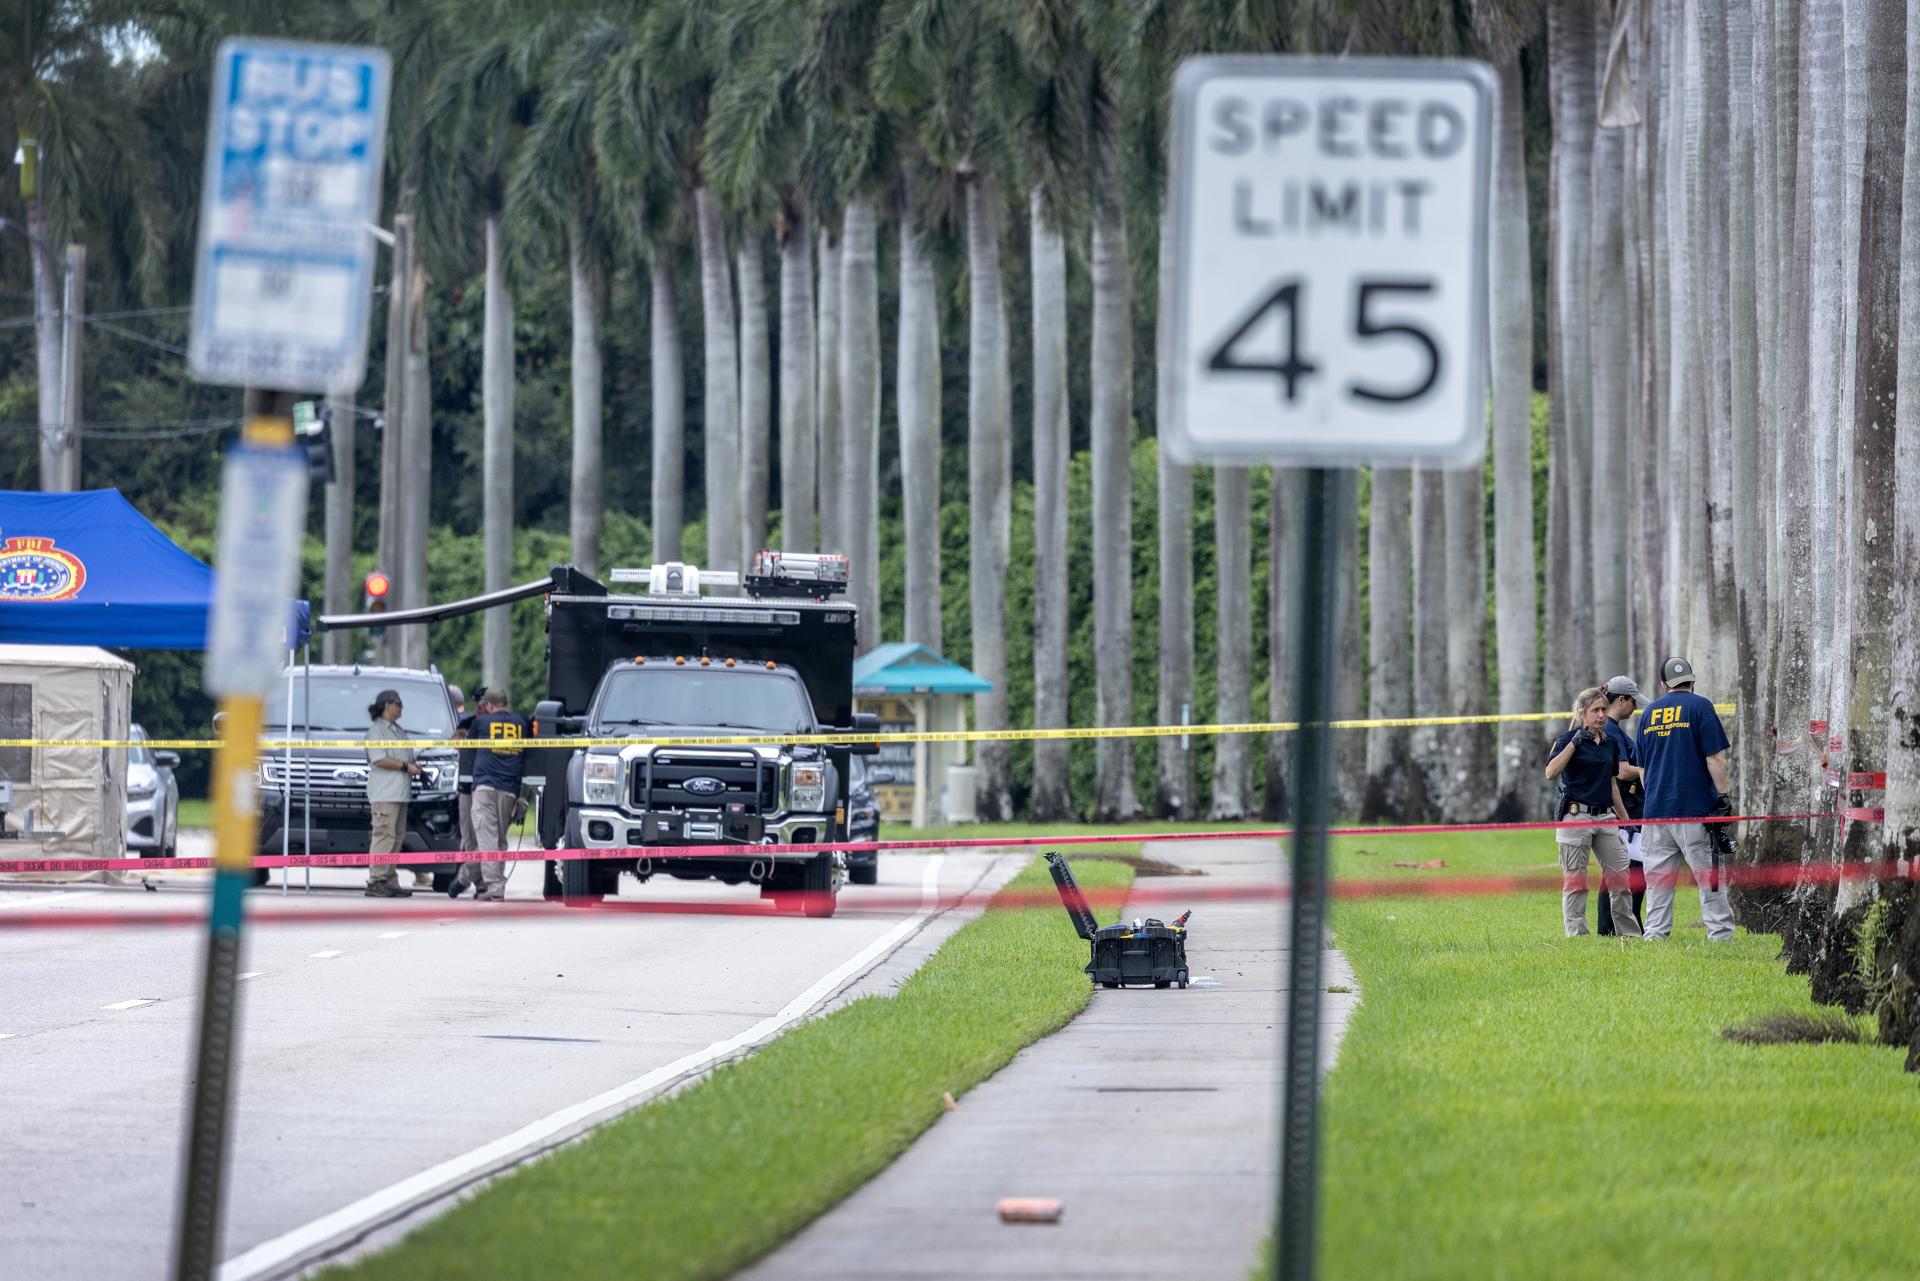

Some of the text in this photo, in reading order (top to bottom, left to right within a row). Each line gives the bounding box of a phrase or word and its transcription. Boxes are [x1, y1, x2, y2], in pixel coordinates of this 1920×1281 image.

[1209, 97, 1468, 160] SPEED
[1232, 179, 1434, 238] LIMIT
[1206, 274, 1441, 405] 45
[490, 722, 522, 740] FBI
[1650, 706, 1682, 724] FBI
[692, 780, 716, 791] Ford
